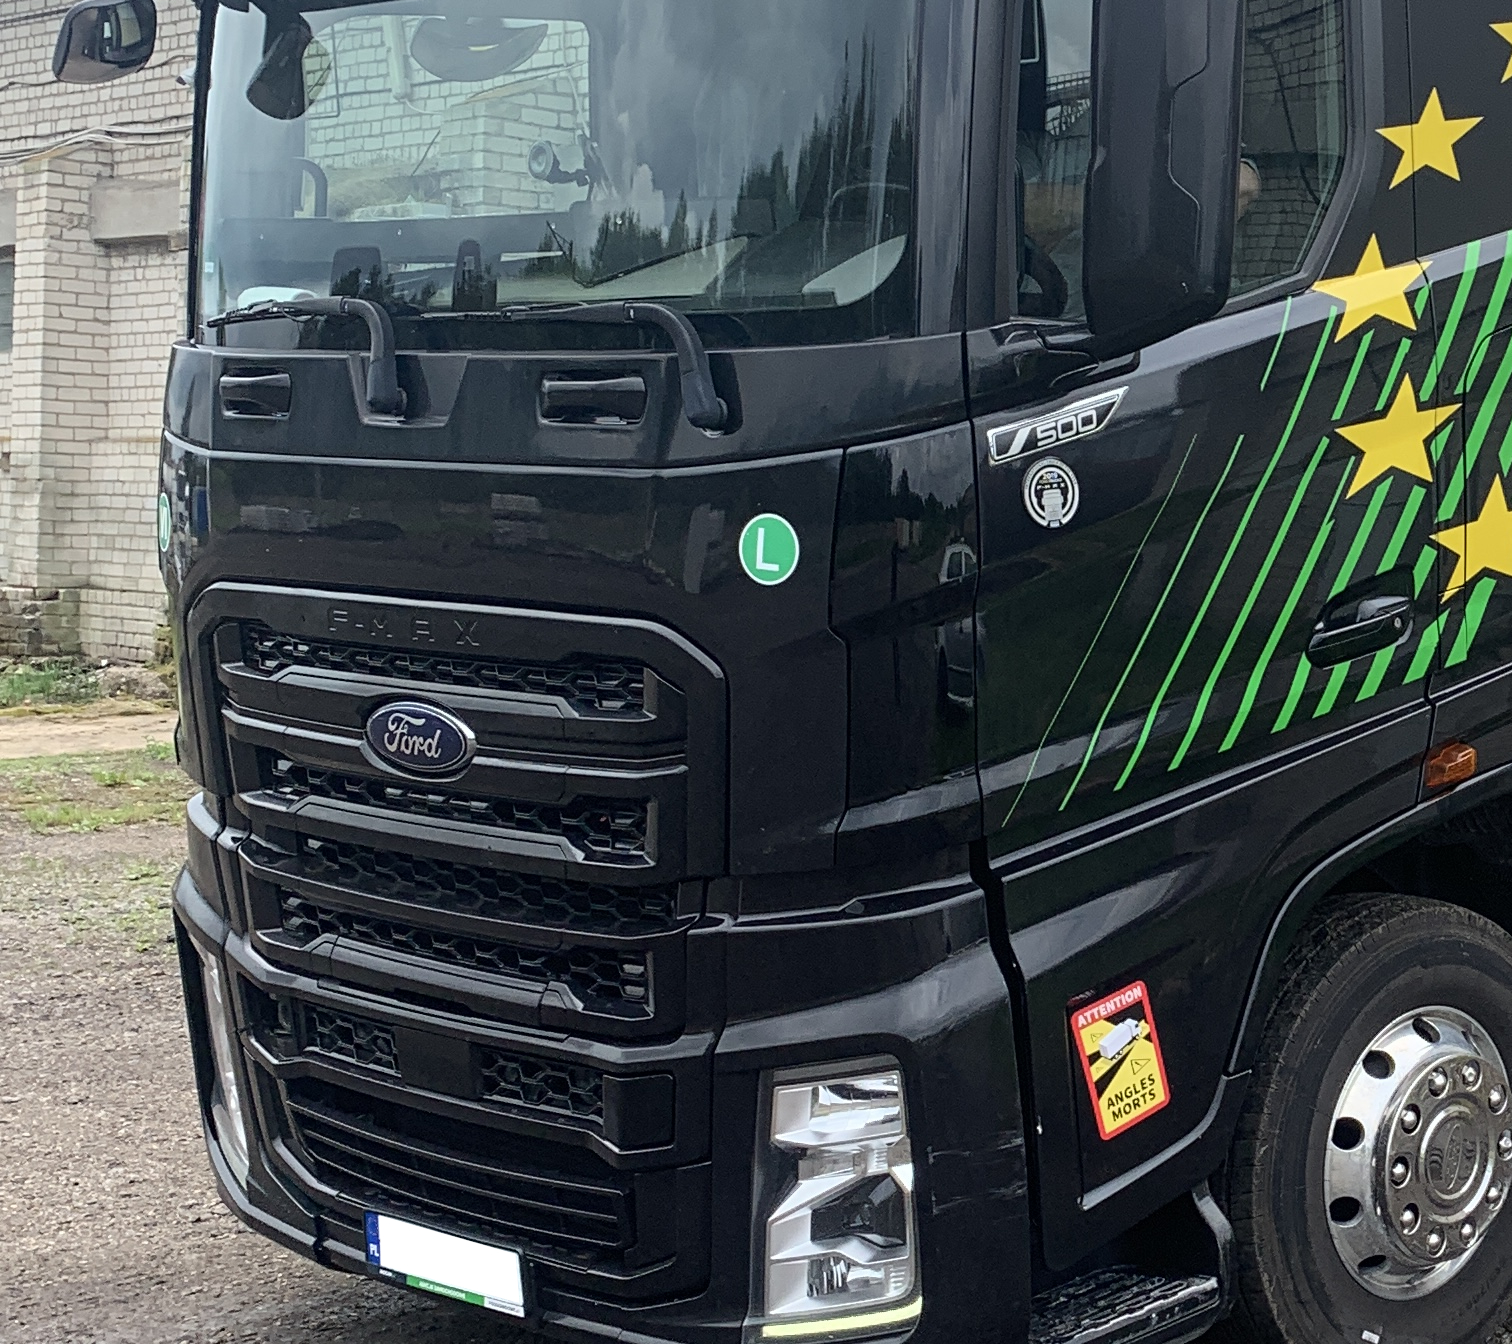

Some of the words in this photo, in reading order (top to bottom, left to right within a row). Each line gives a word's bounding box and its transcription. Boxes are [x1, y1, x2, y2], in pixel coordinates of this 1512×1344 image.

[1036, 408, 1098, 447] 500
[755, 527, 780, 572] L
[383, 712, 443, 759] Ford
[1077, 985, 1143, 1028] ATTENTION
[1107, 1073, 1156, 1110] ANGLES
[1111, 1088, 1156, 1122] MORTS
